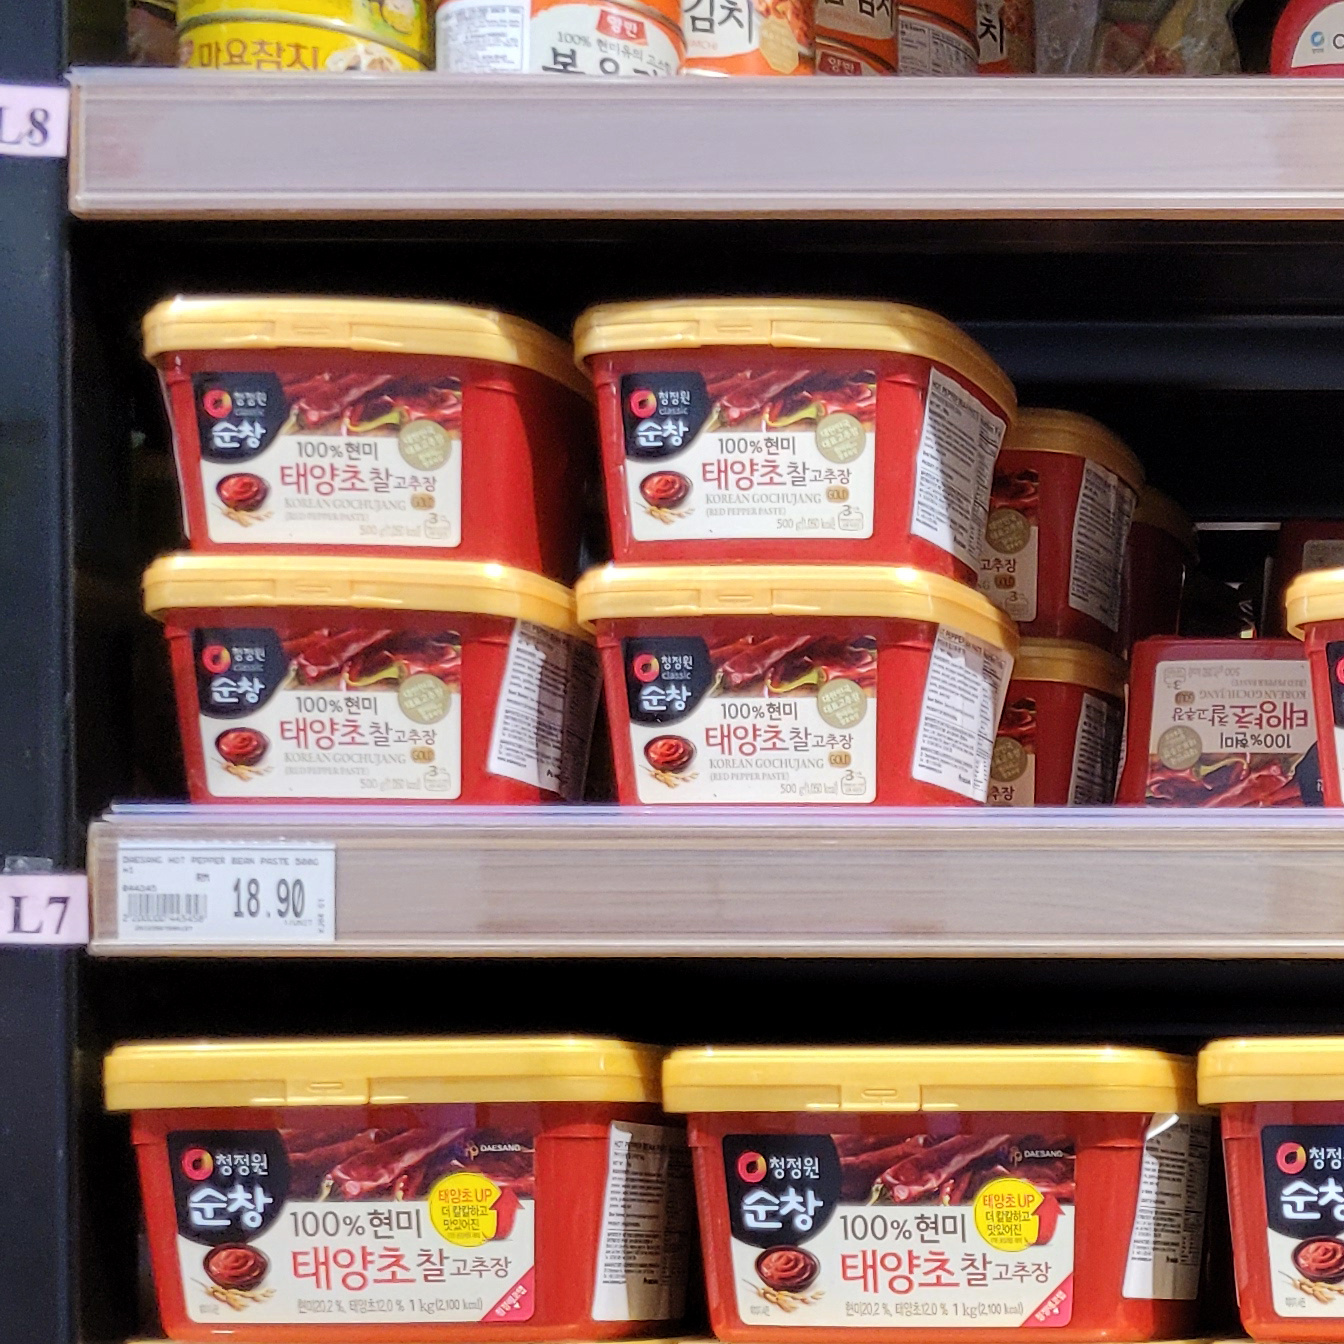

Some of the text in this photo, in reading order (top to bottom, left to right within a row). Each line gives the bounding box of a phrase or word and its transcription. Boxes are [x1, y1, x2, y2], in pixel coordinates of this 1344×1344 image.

[0, 106, 51, 148] L8
[640, 684, 692, 712] 순창
[7, 895, 72, 935] L7
[233, 877, 306, 919] 18.90
[188, 1183, 273, 1229] 순창
